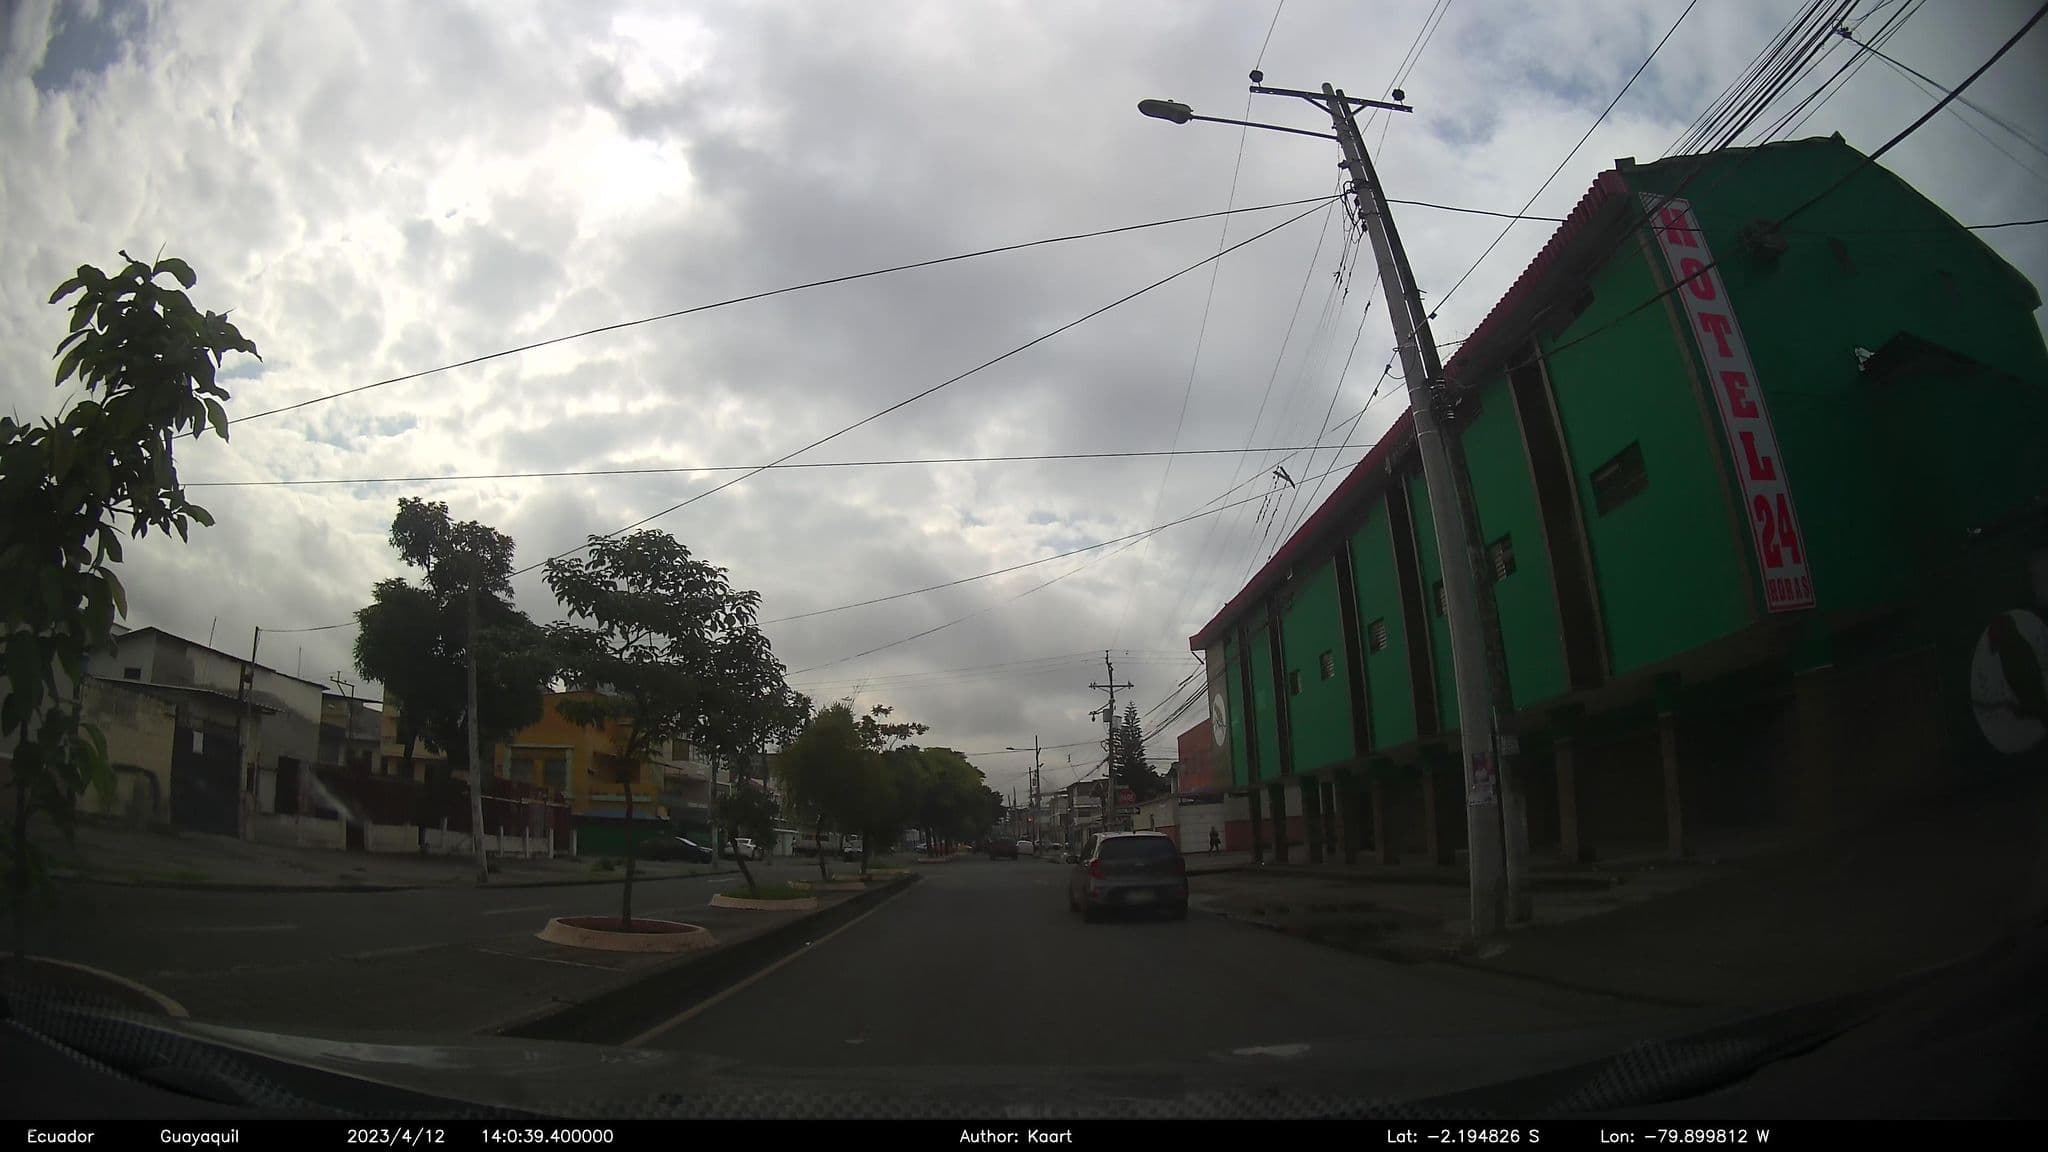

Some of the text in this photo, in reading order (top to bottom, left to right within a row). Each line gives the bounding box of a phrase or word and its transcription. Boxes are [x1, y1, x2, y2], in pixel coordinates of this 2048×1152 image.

[1659, 207, 1777, 481] HOTEL
[1754, 493, 1802, 568] 24
[1767, 576, 1811, 601] HORAS
